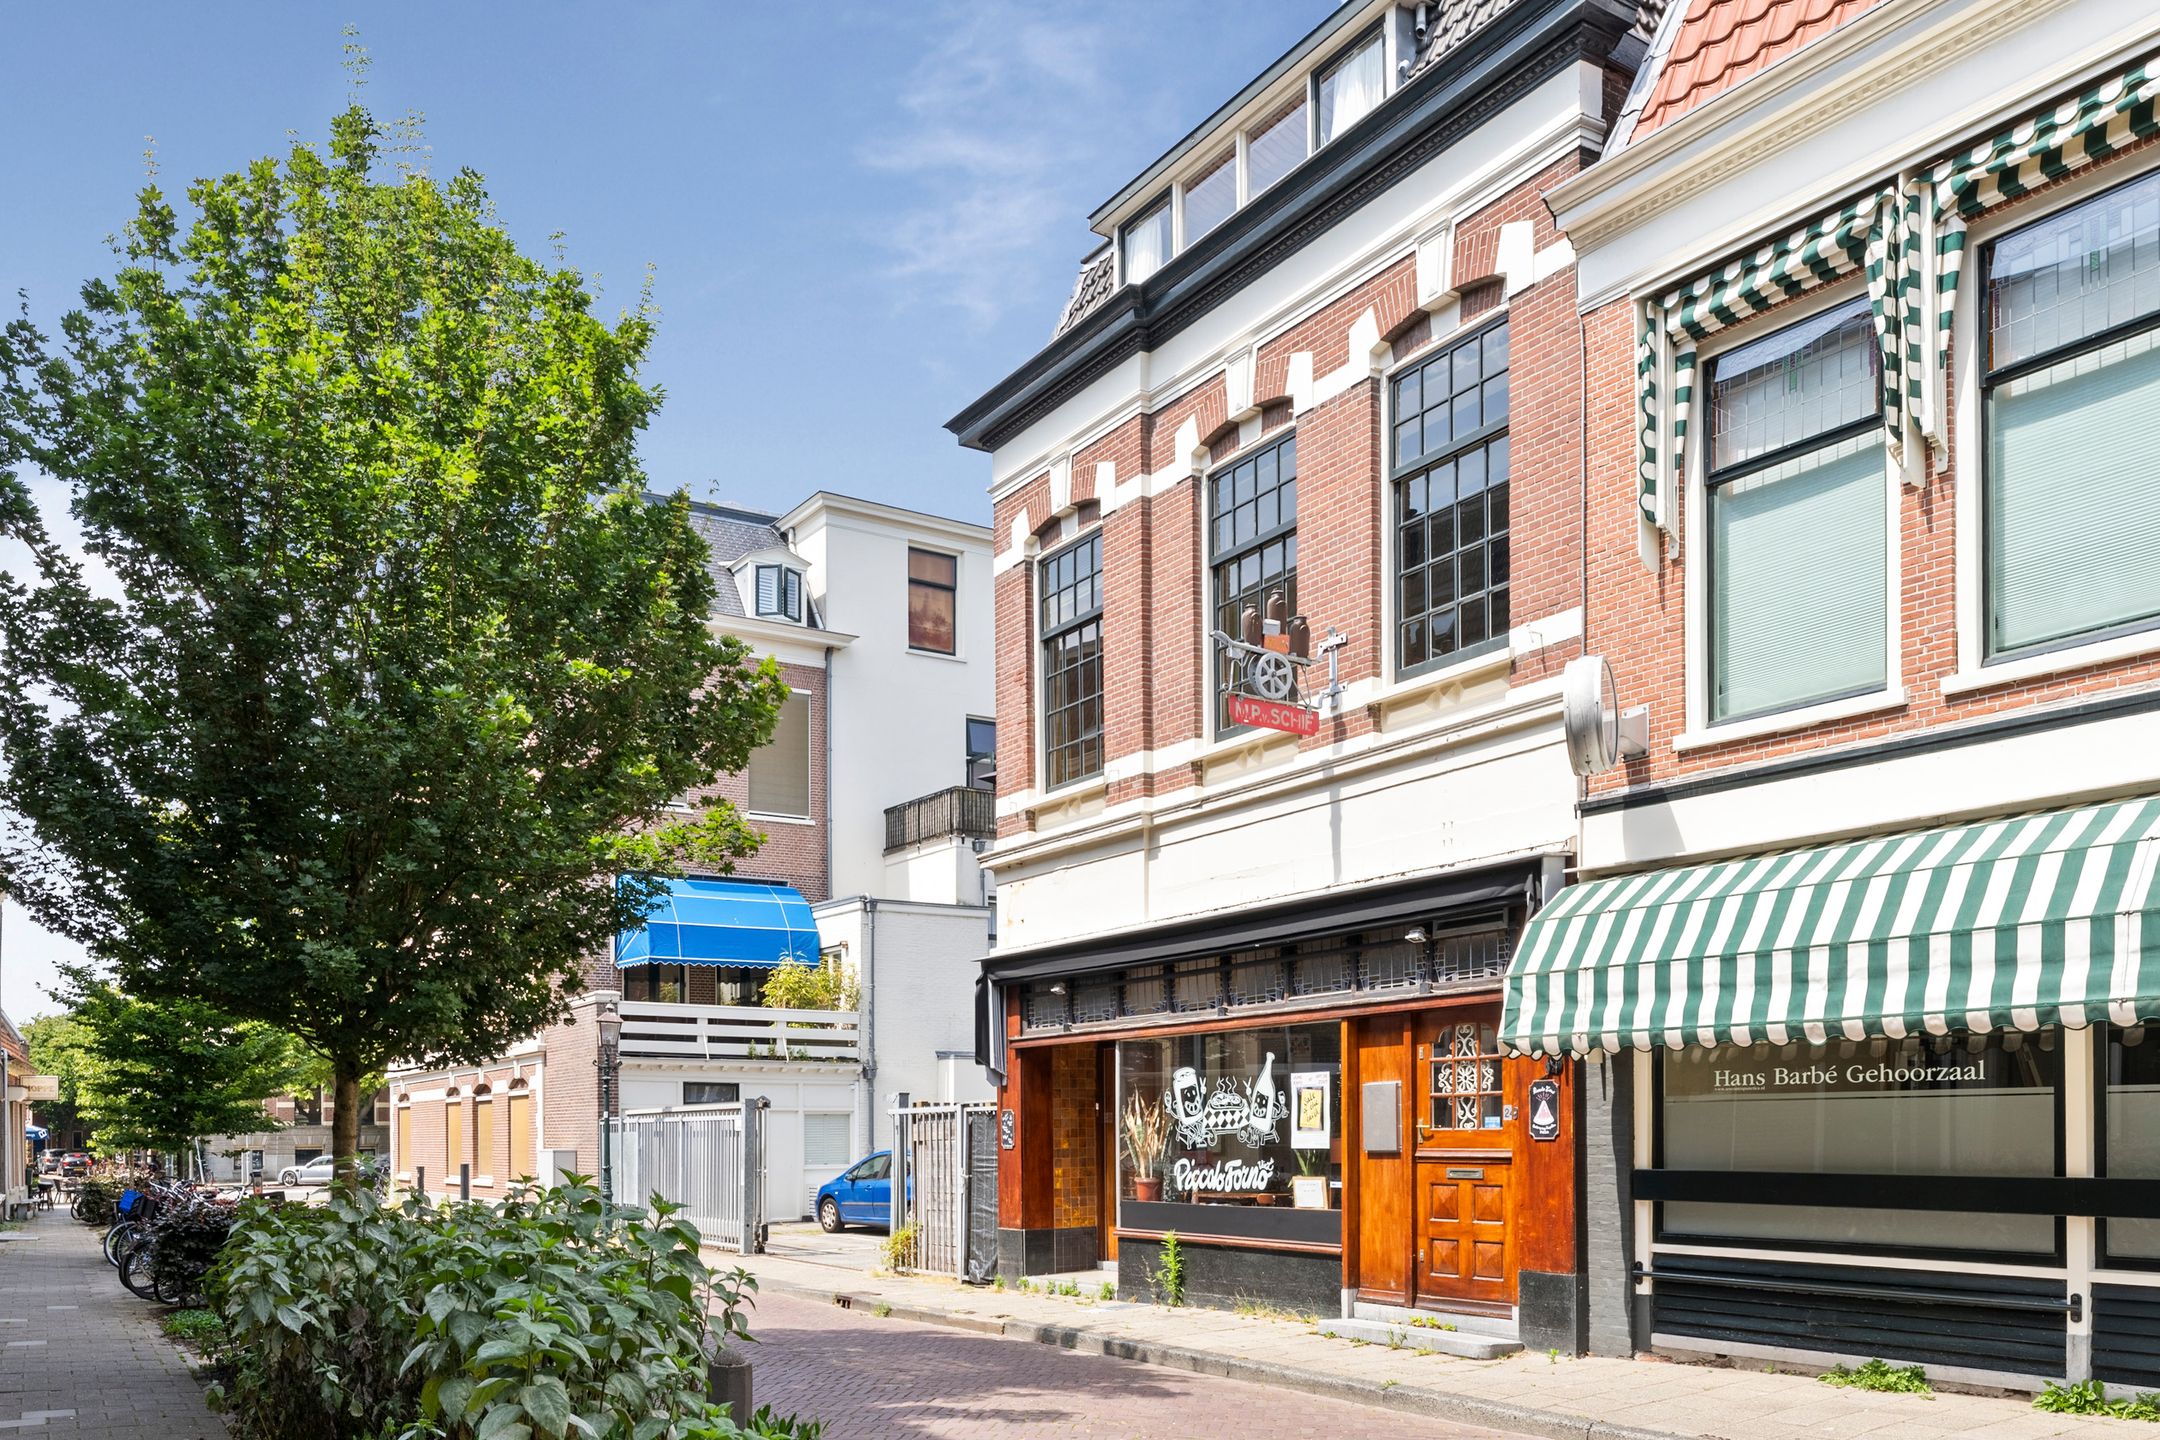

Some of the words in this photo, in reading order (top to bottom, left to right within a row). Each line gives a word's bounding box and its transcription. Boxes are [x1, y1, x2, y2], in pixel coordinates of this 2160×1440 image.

[1714, 1070, 1766, 1087] Hans
[1773, 1065, 1838, 1085] Barbé
[1846, 1060, 1986, 1083] Gehoorzaal
[1174, 1158, 1226, 1191] Piccolo
[1225, 1158, 1274, 1192] Forno
